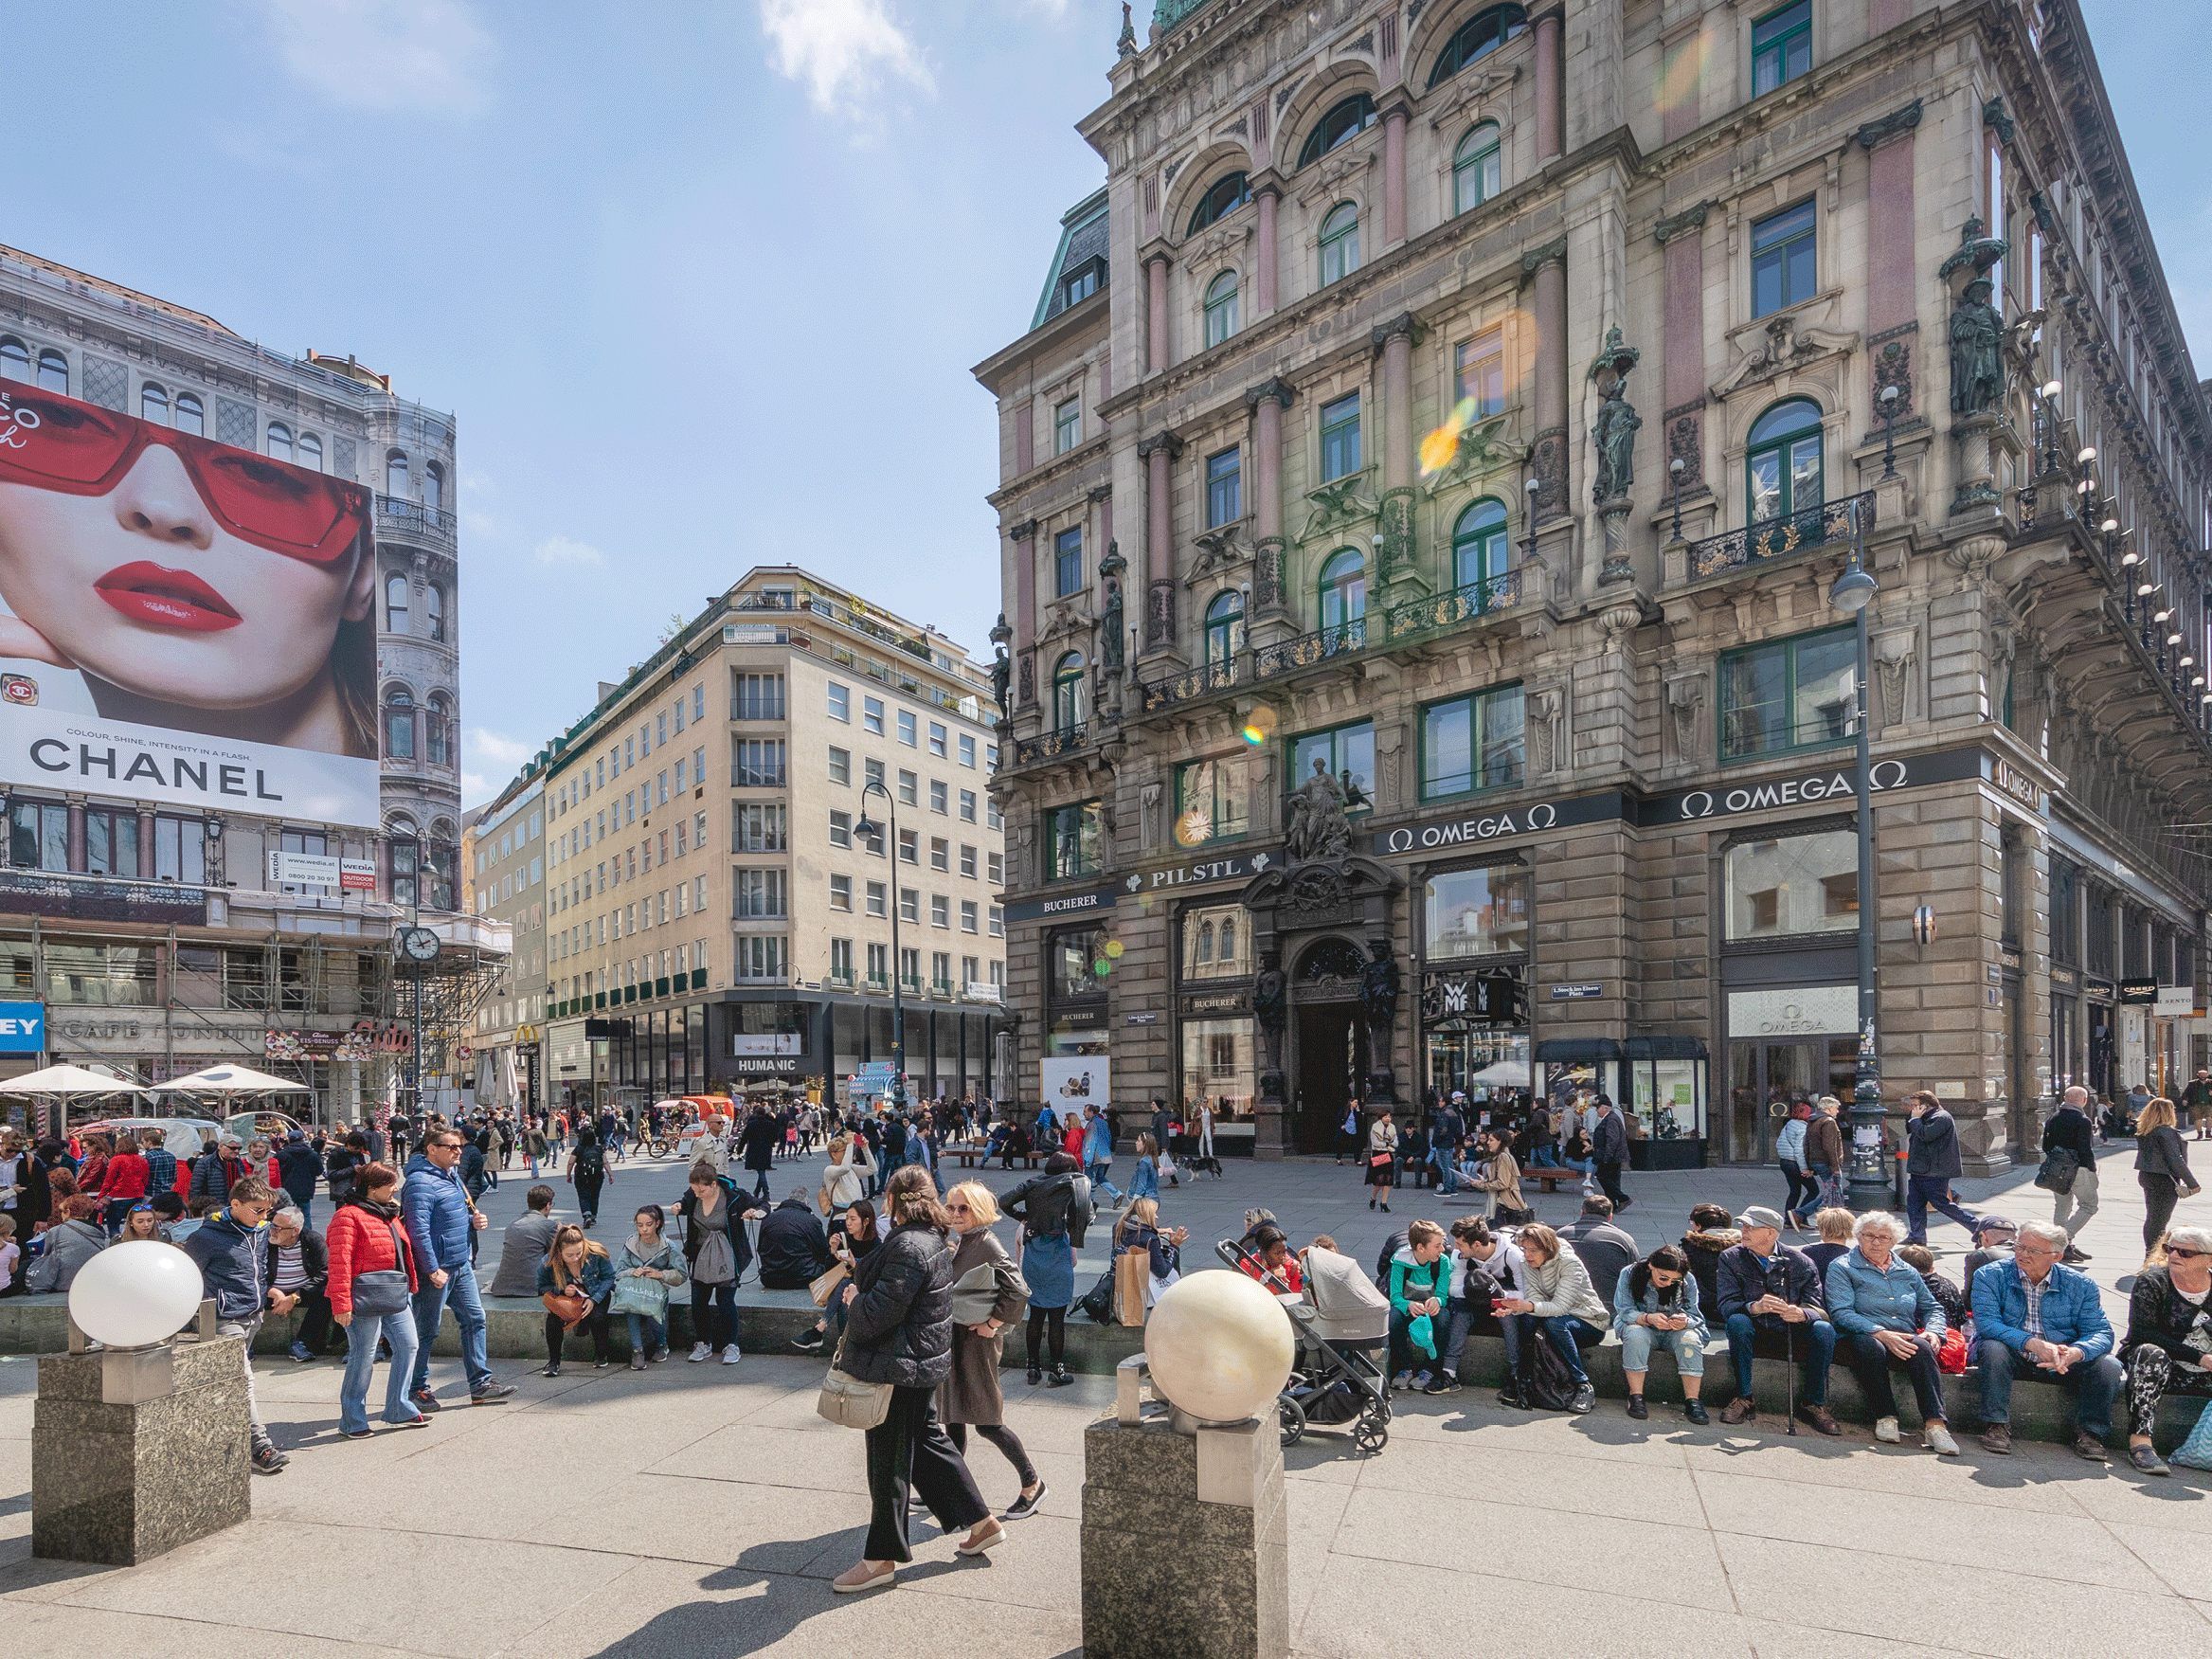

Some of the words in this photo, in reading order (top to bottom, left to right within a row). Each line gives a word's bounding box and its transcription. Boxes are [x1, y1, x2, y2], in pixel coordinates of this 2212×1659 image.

[66, 728, 112, 741] COLOUR,
[114, 735, 146, 747] SHINE,
[149, 741, 198, 753] INTENSITY
[29, 738, 283, 802] CHANEL
[1725, 772, 1854, 812] OMEGA
[2008, 770, 2034, 805] OMEGA
[1421, 814, 1517, 847] OMEGA
[287, 857, 335, 868] www.wedia.at
[343, 875, 374, 883] OUTDOOR
[1152, 859, 1241, 888] PILSTL
[1044, 894, 1098, 912] BUCHERER
[2124, 985, 2155, 997] CREED
[1195, 998, 1236, 1008] BUCHERER
[1061, 1012, 1094, 1021] BUCHERER
[1760, 1020, 1827, 1034] OMEGA
[739, 1059, 796, 1072] HUMANIC
